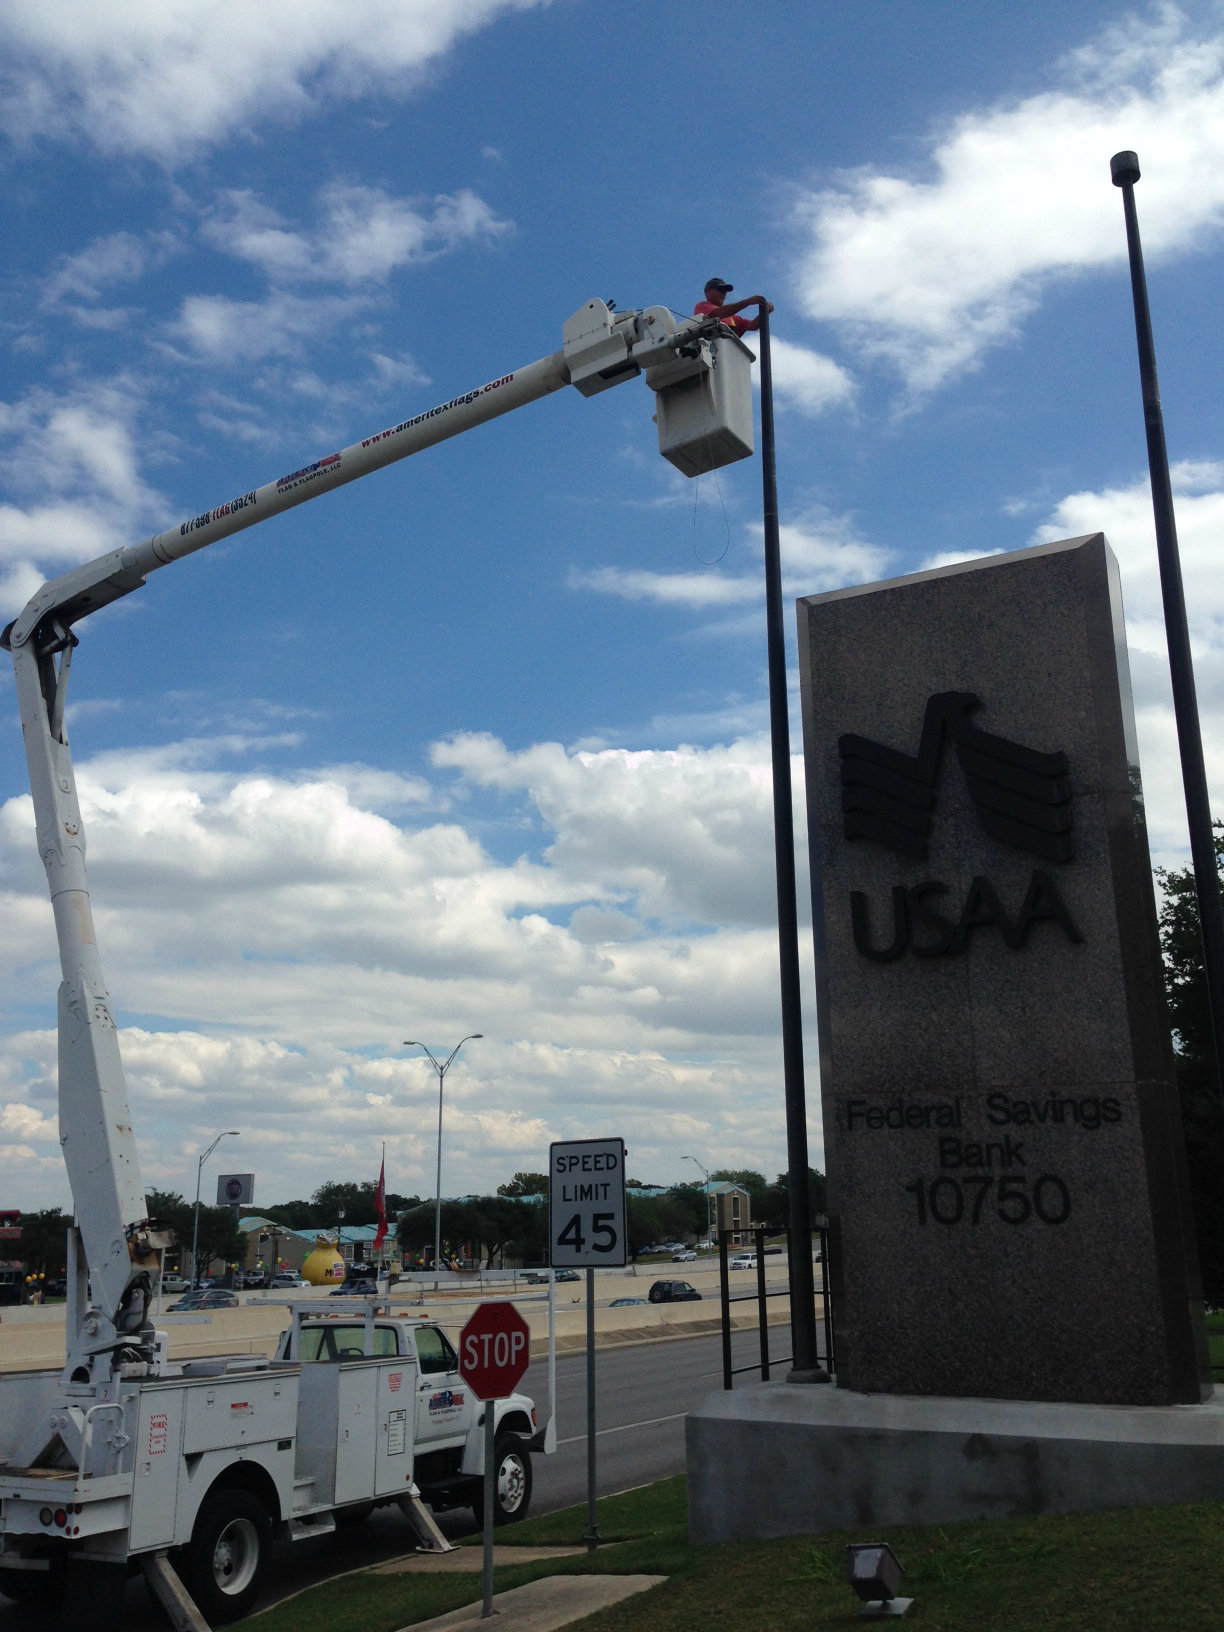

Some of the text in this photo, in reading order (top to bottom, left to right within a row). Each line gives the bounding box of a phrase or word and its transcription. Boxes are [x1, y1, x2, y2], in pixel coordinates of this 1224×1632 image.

[361, 374, 514, 448] www.ameritexflags.com
[850, 869, 1085, 961] USAA
[846, 1092, 1122, 1130] Federal Savings
[556, 1153, 618, 1174] SPEED
[938, 1135, 1027, 1169] Bank
[562, 1183, 611, 1202] LIMIT
[905, 1174, 1071, 1226] 10750
[556, 1212, 618, 1254] 45
[463, 1331, 525, 1371] STOP
